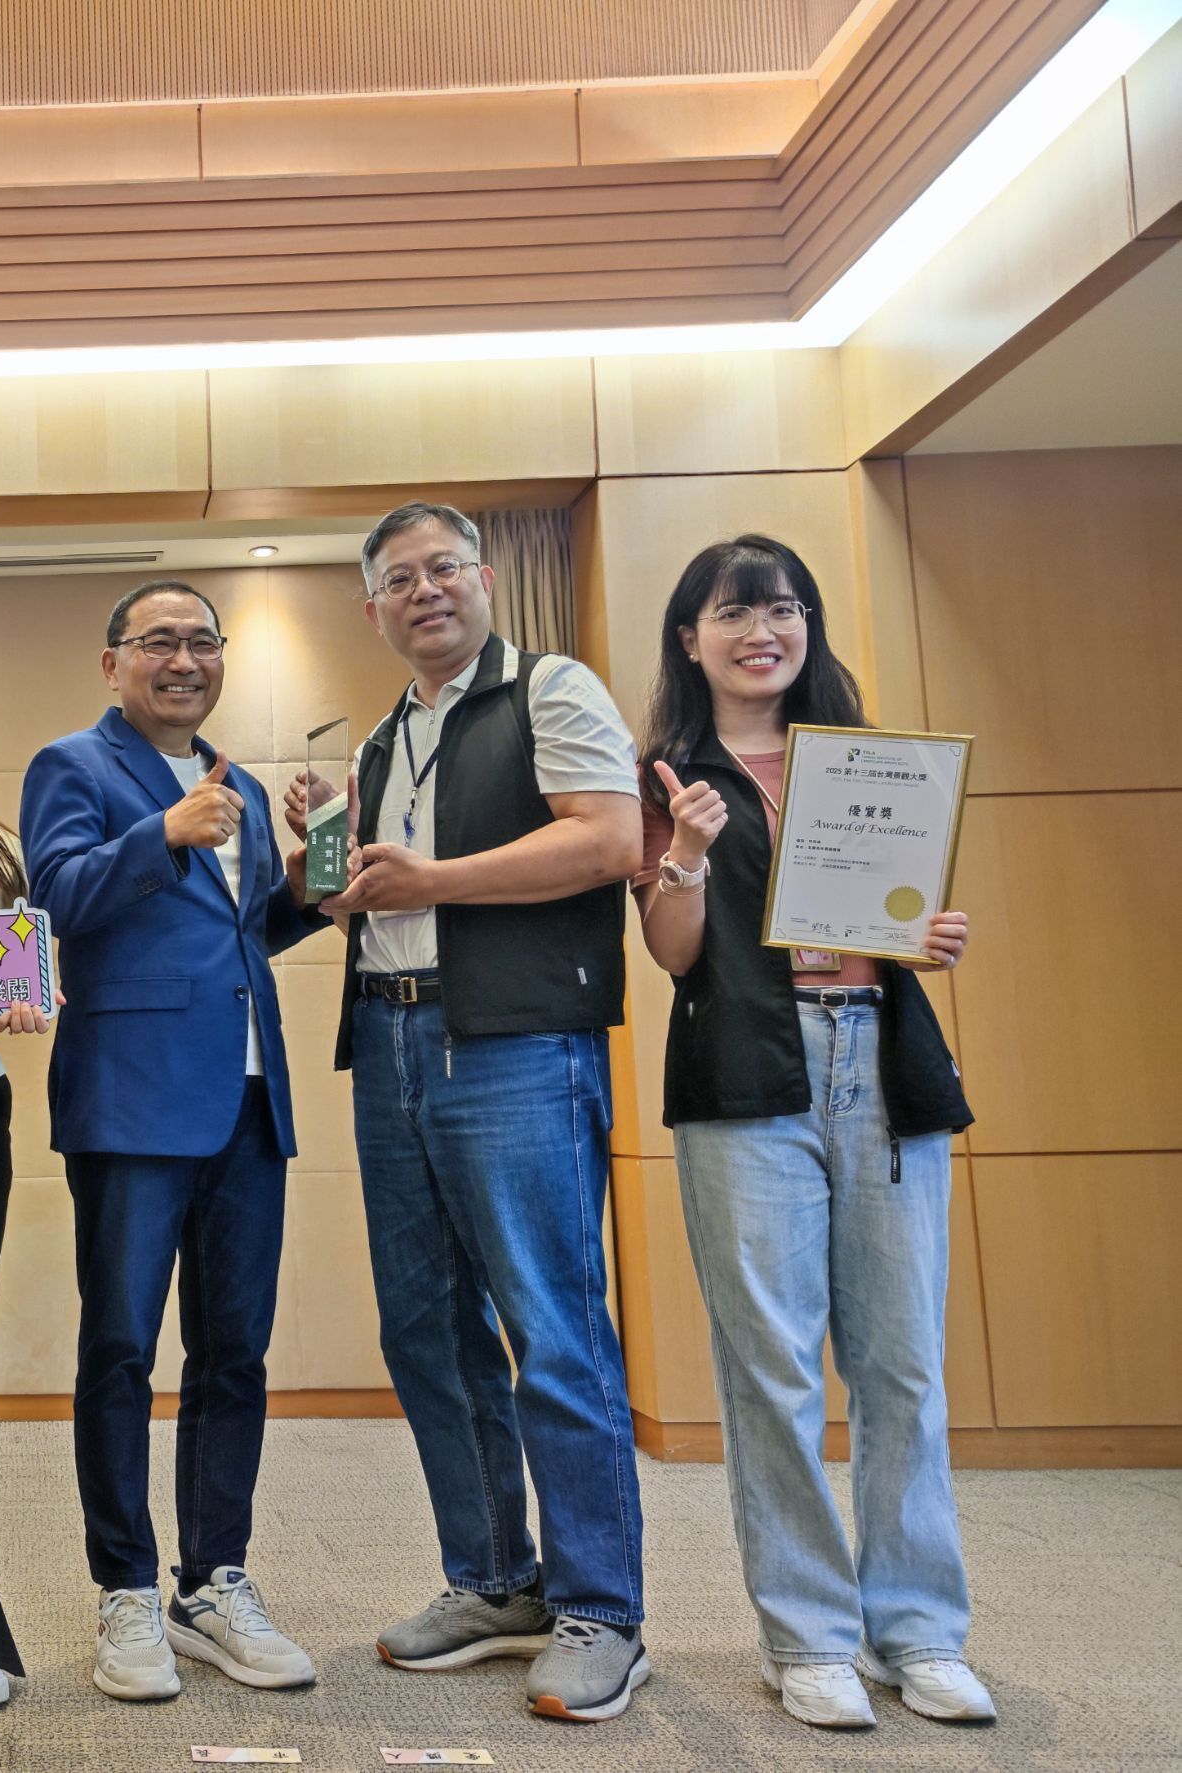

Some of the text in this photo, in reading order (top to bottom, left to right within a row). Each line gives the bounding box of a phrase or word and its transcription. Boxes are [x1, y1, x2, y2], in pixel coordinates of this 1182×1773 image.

[848, 804, 893, 820] 優質獎
[810, 819, 928, 838] Award of Excellence
